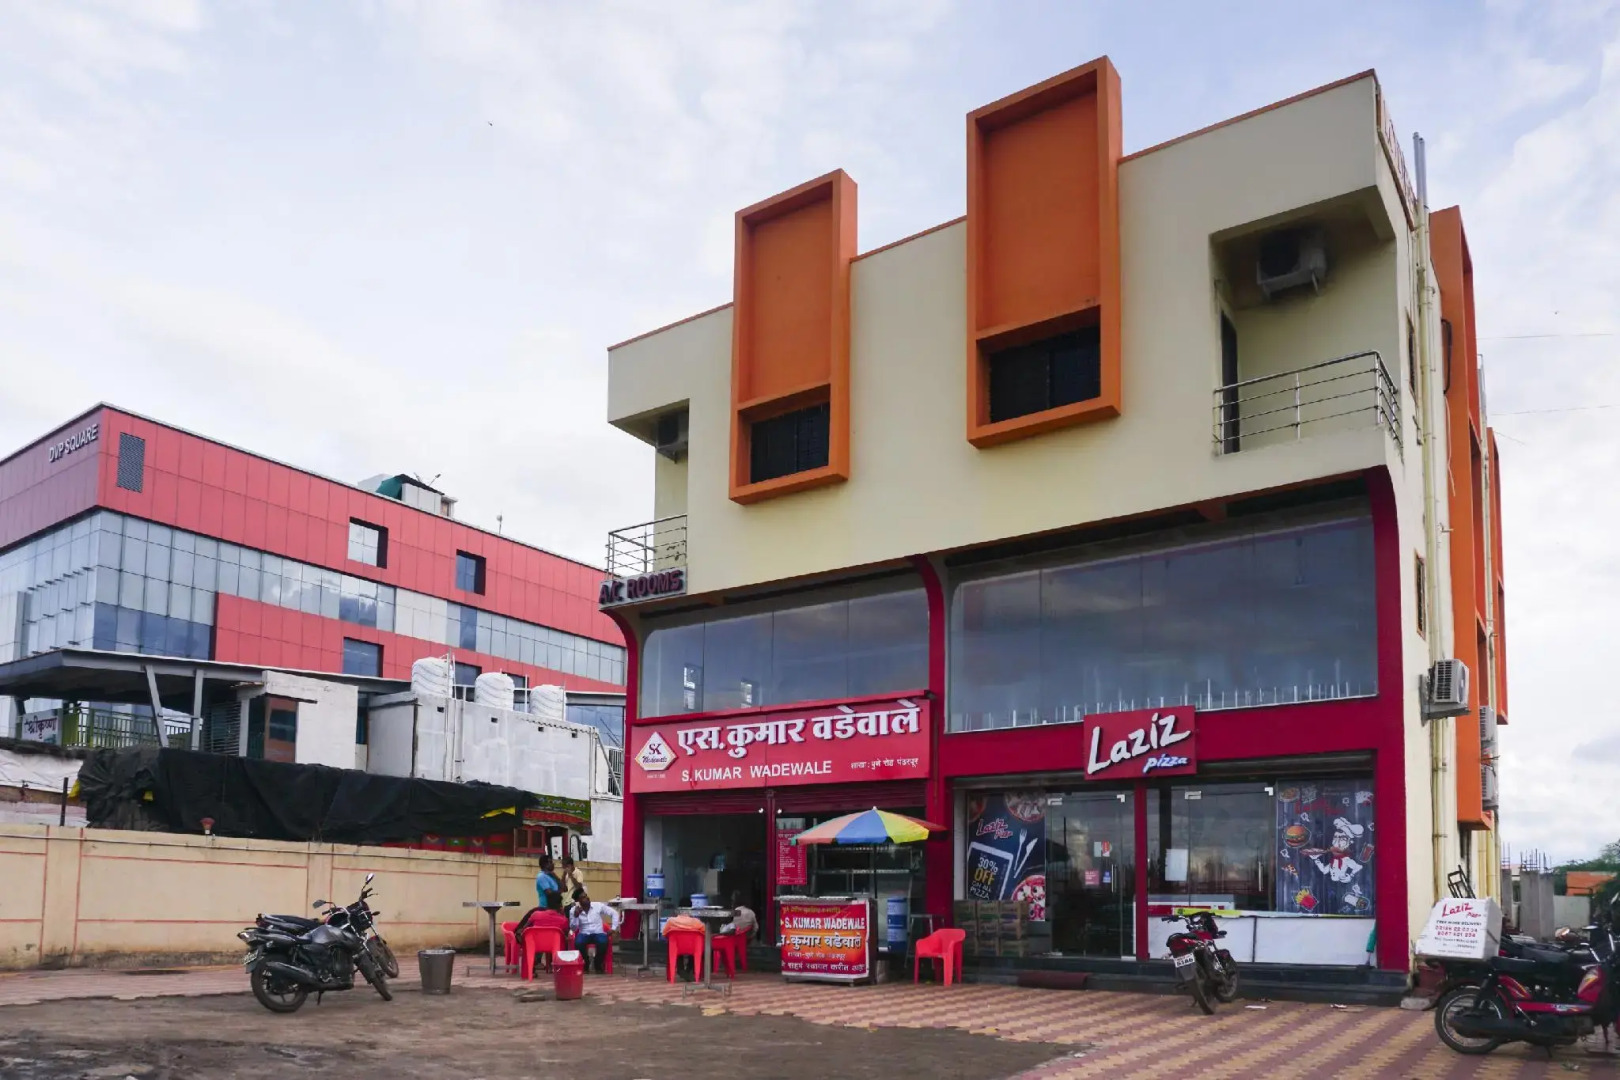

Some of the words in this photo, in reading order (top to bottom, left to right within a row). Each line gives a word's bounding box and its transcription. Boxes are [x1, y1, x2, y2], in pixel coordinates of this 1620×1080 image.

[49, 442, 65, 463] DVP
[65, 423, 99, 454] SQUARE
[627, 570, 683, 599] ROOMS
[811, 698, 921, 739] वडेवाले
[1087, 712, 1191, 775] Laziz
[750, 760, 832, 778] WADEWALE
[1142, 753, 1188, 774] pizza
[974, 867, 995, 885] OFF
[978, 857, 998, 874] 30%
[1442, 903, 1473, 917] Laziz
